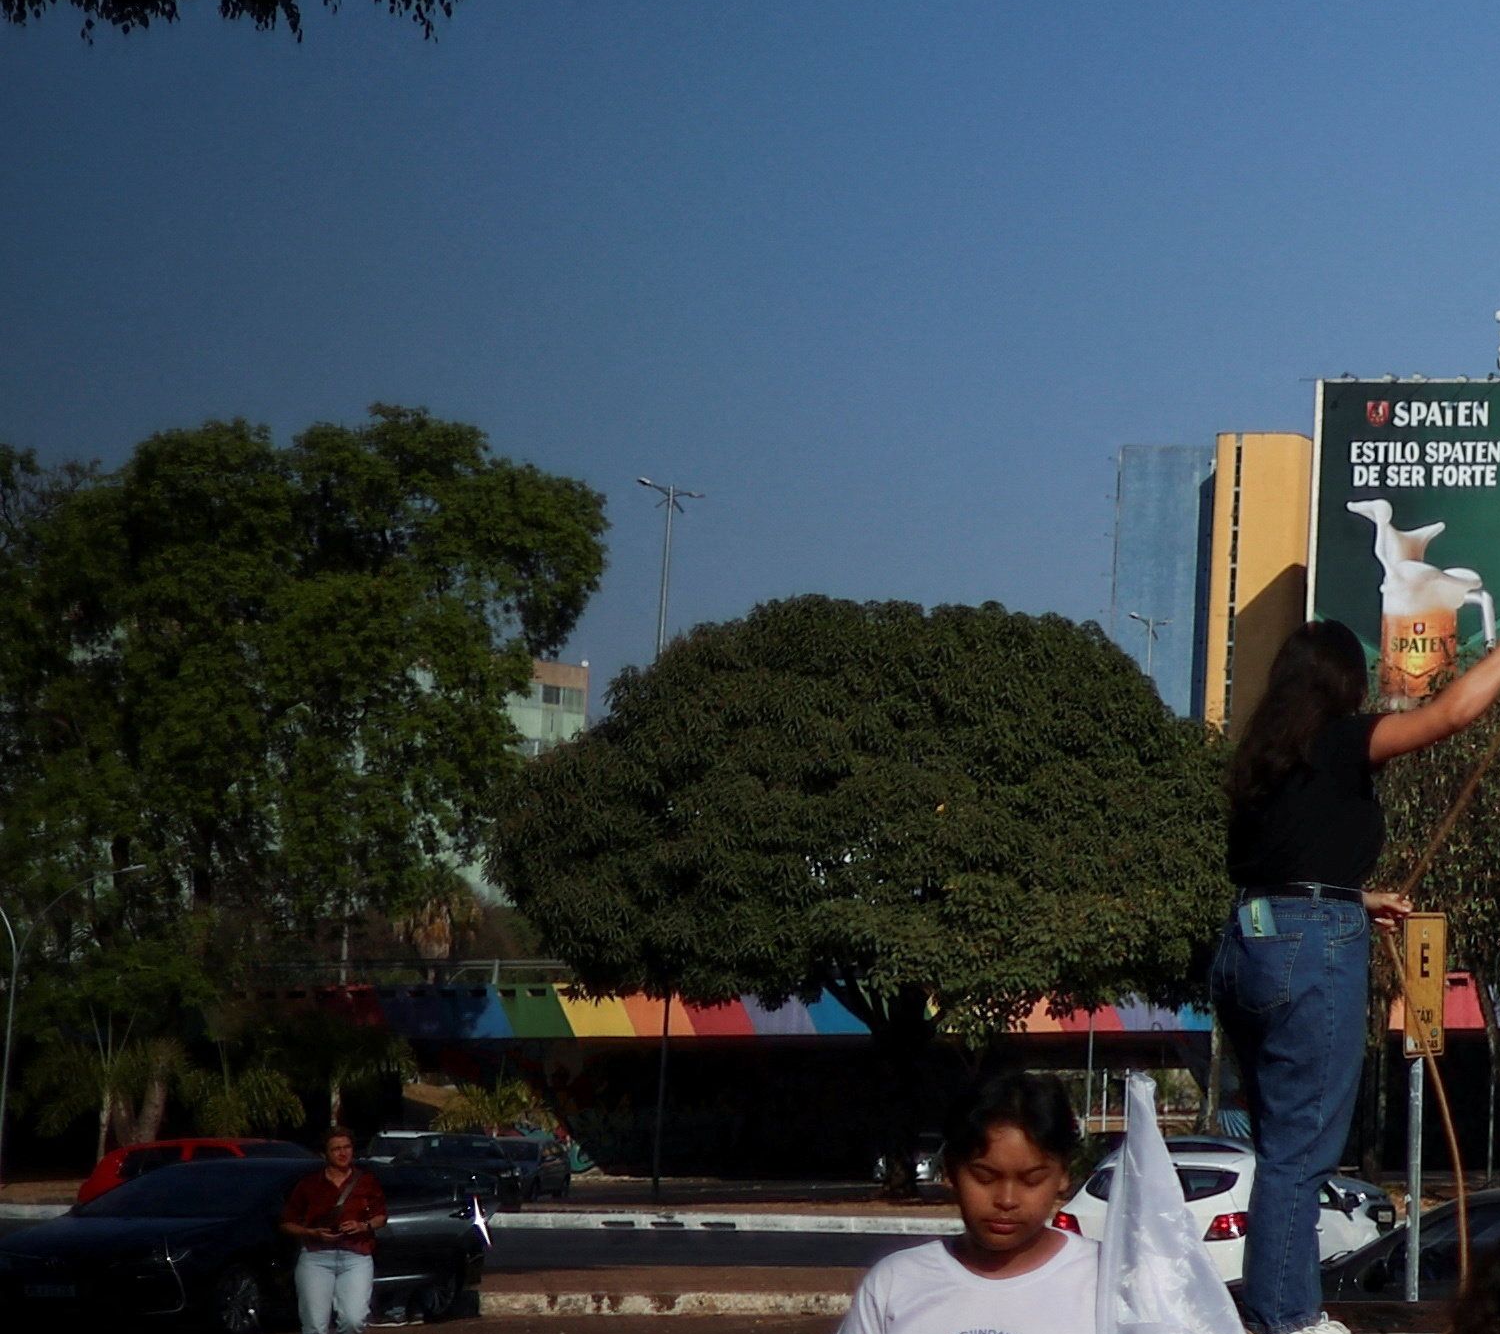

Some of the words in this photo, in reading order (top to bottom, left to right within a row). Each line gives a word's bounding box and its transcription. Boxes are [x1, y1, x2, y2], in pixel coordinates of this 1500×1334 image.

[1393, 401, 1489, 427] SPATEN
[1351, 442, 1419, 463] ESTILO
[1425, 442, 1500, 463] SPATEN
[1353, 465, 1380, 487] DE
[1386, 465, 1425, 487] SER
[1431, 465, 1497, 487] FORTE
[1421, 943, 1430, 978] E
